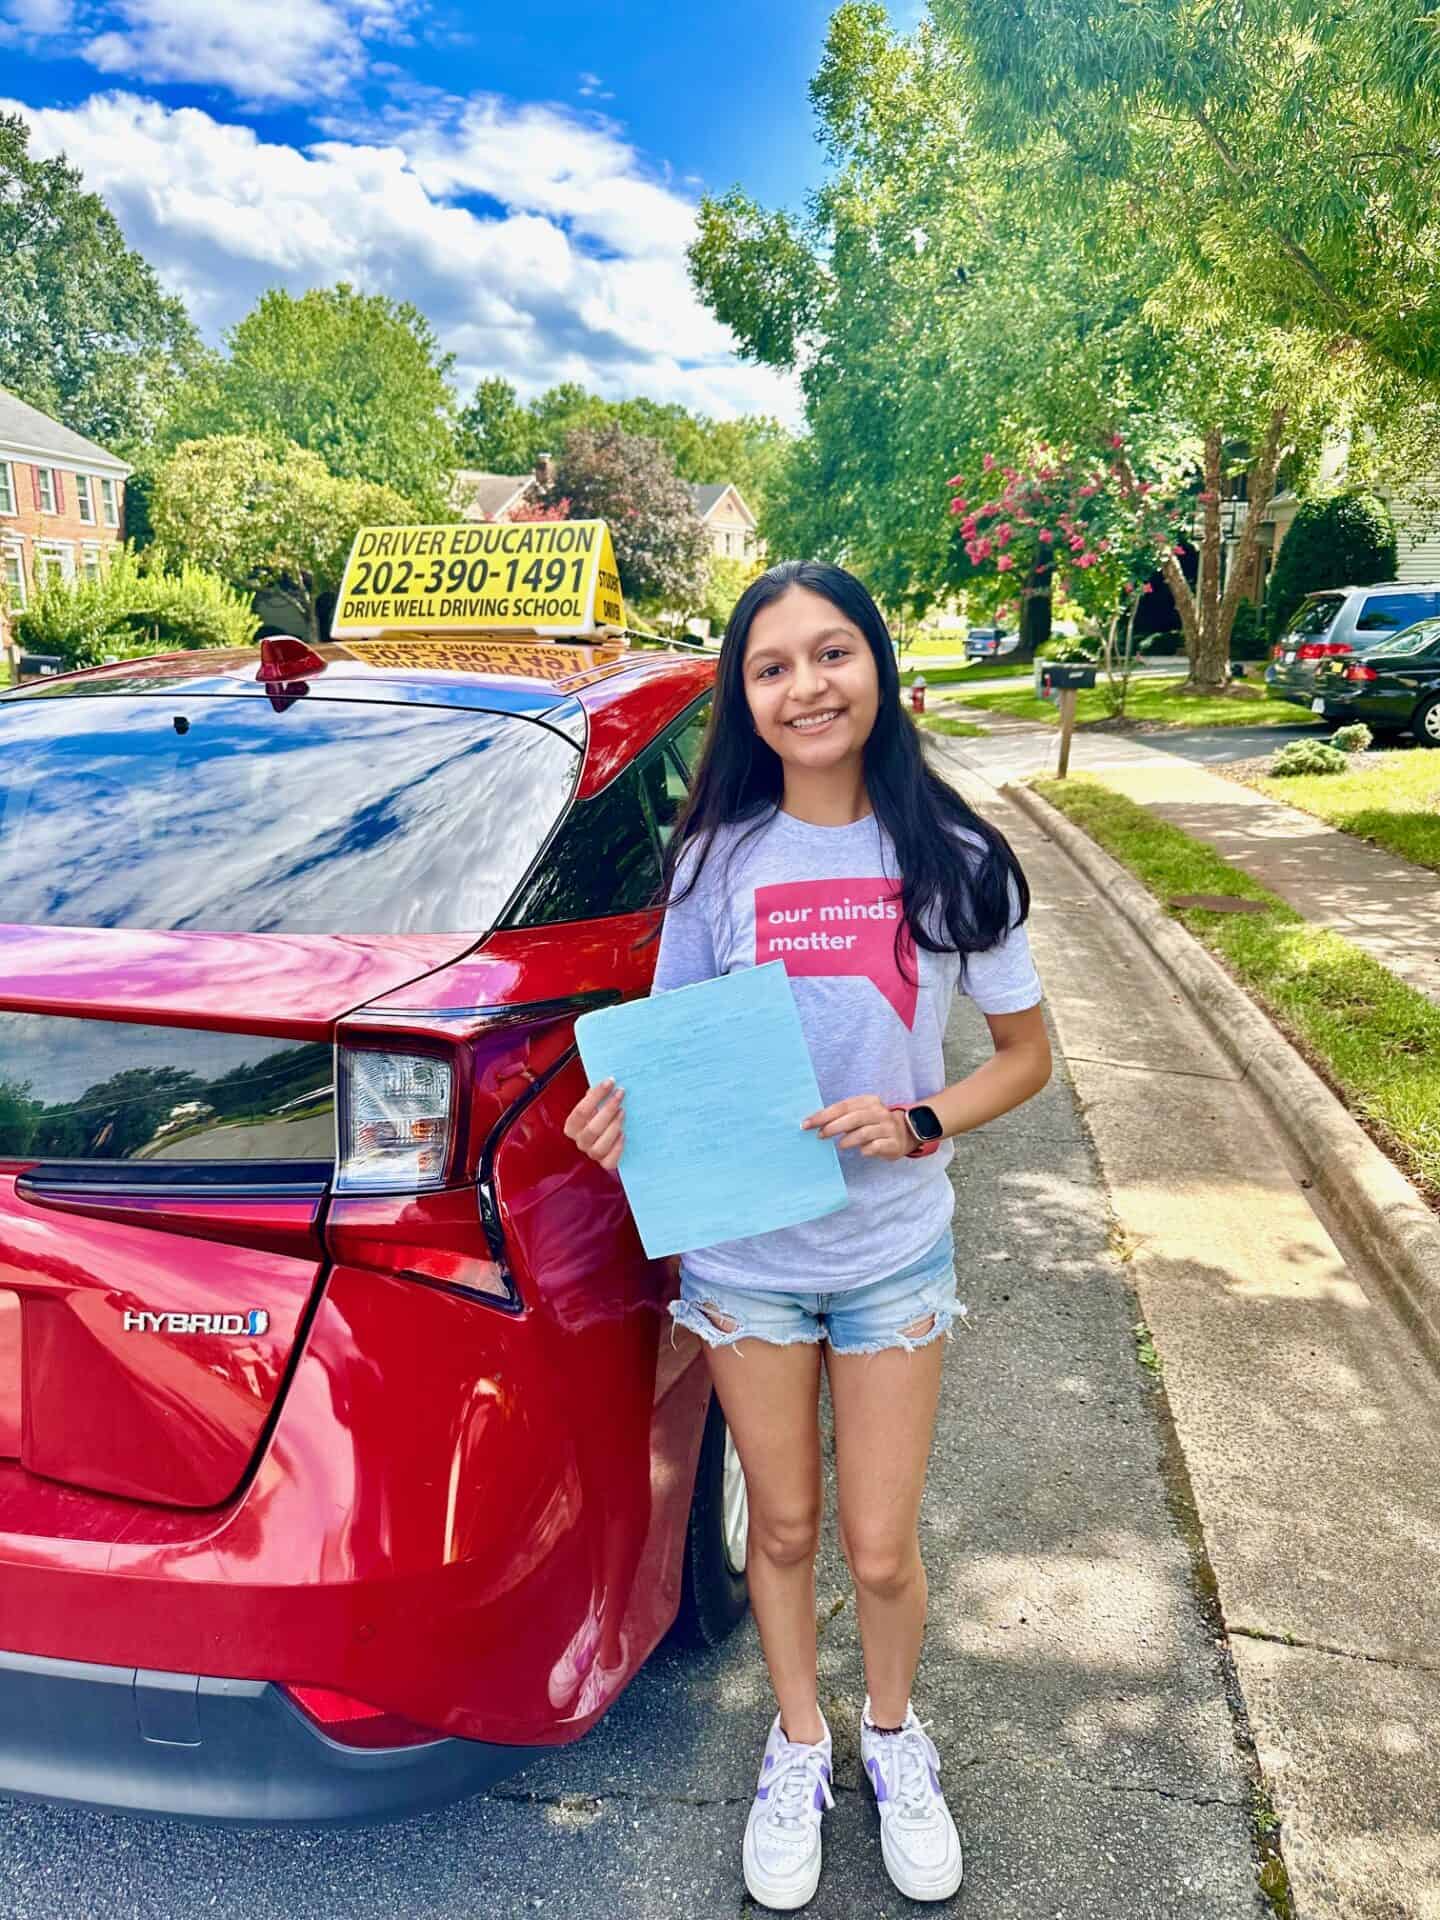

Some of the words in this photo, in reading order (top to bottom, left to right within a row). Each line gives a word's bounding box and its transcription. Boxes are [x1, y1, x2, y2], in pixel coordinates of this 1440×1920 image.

[358, 531, 447, 557] DRIVER
[450, 527, 595, 554] EDUCATION
[350, 558, 585, 595] 202-390-1491
[343, 600, 391, 618] DRIVE
[394, 599, 435, 617] WELL
[440, 598, 509, 617] DRIVING
[512, 598, 582, 617] SCHOOL
[768, 907, 813, 924] our
[819, 896, 898, 921] minds
[769, 932, 858, 952] matter
[123, 1311, 244, 1335] HYBRID
